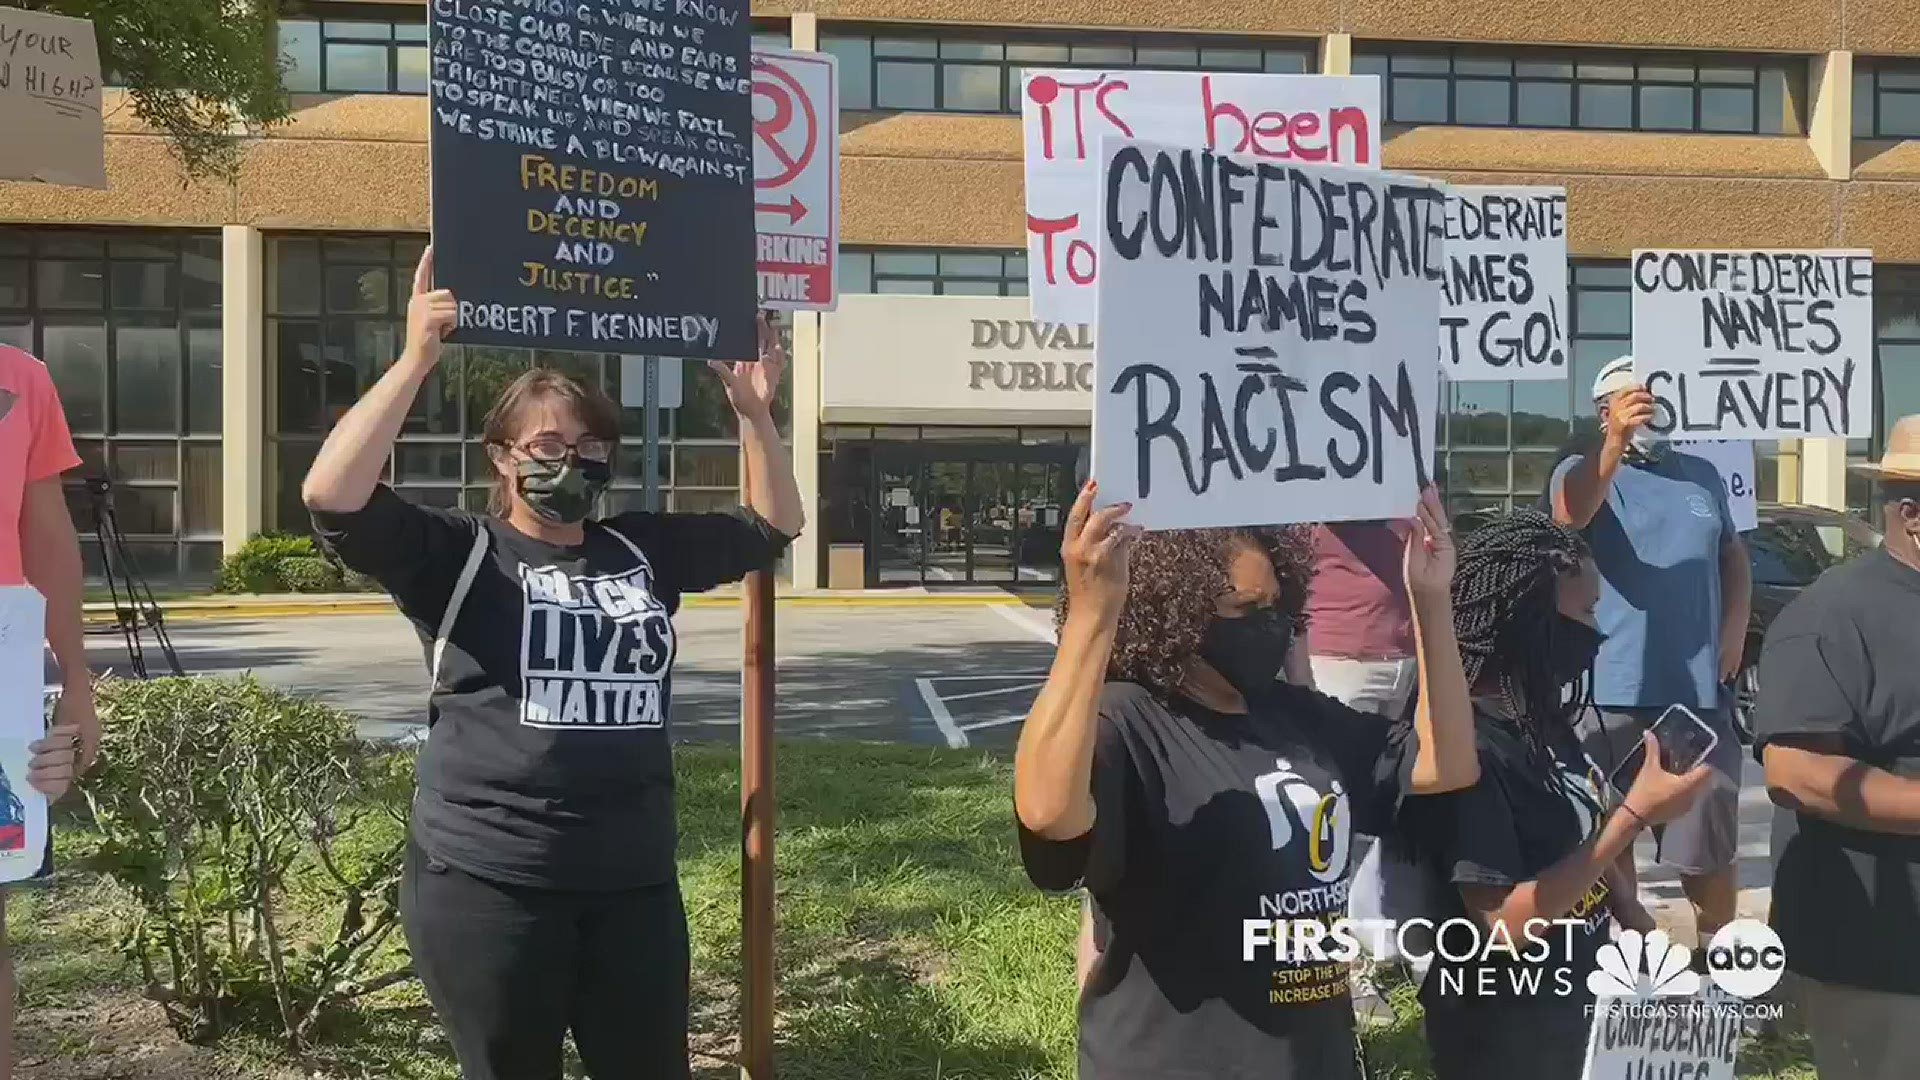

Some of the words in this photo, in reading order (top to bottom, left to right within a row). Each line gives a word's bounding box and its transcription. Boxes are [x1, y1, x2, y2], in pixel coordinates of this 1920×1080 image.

[1, 24, 74, 60] YOUR
[434, 0, 514, 31] CLOSE
[520, 15, 573, 46] OUR
[630, 37, 675, 60] AND
[681, 46, 738, 73] EARS
[436, 21, 466, 41] TO
[472, 28, 511, 51] THE
[515, 36, 613, 75] CORRUPT
[715, 75, 751, 96] WE
[434, 37, 475, 62] ARE
[482, 49, 525, 77] TOO
[531, 59, 588, 94] BUSY
[624, 81, 665, 103] TOO
[436, 104, 474, 135] WE
[478, 117, 558, 150] STRIKE
[566, 133, 588, 159] A
[677, 109, 737, 139] FAIL
[1201, 75, 1370, 165] been
[520, 153, 660, 201] FREEDOM
[527, 208, 648, 246] DECENCY
[553, 193, 621, 220] AND
[1105, 145, 1446, 290] CONFEDERATE
[1442, 195, 1567, 242] EDERATE
[555, 240, 615, 266] AND
[756, 233, 828, 265] RKING
[1634, 252, 1873, 299] CONFEDERATE
[459, 300, 558, 338] ROBERT
[591, 311, 720, 348] KENNEDY
[1199, 267, 1377, 345] NAMES
[1701, 291, 1842, 355] NAMES
[971, 319, 1094, 350] DUVAL
[1479, 295, 1565, 368] GO!
[968, 360, 1094, 392] PUBLIC
[1645, 357, 1857, 436] SLAVERY
[1110, 361, 1432, 500] RACISM
[528, 608, 670, 675] LIVES
[526, 678, 661, 725] MATTER
[1269, 983, 1331, 1004] INCREASE
